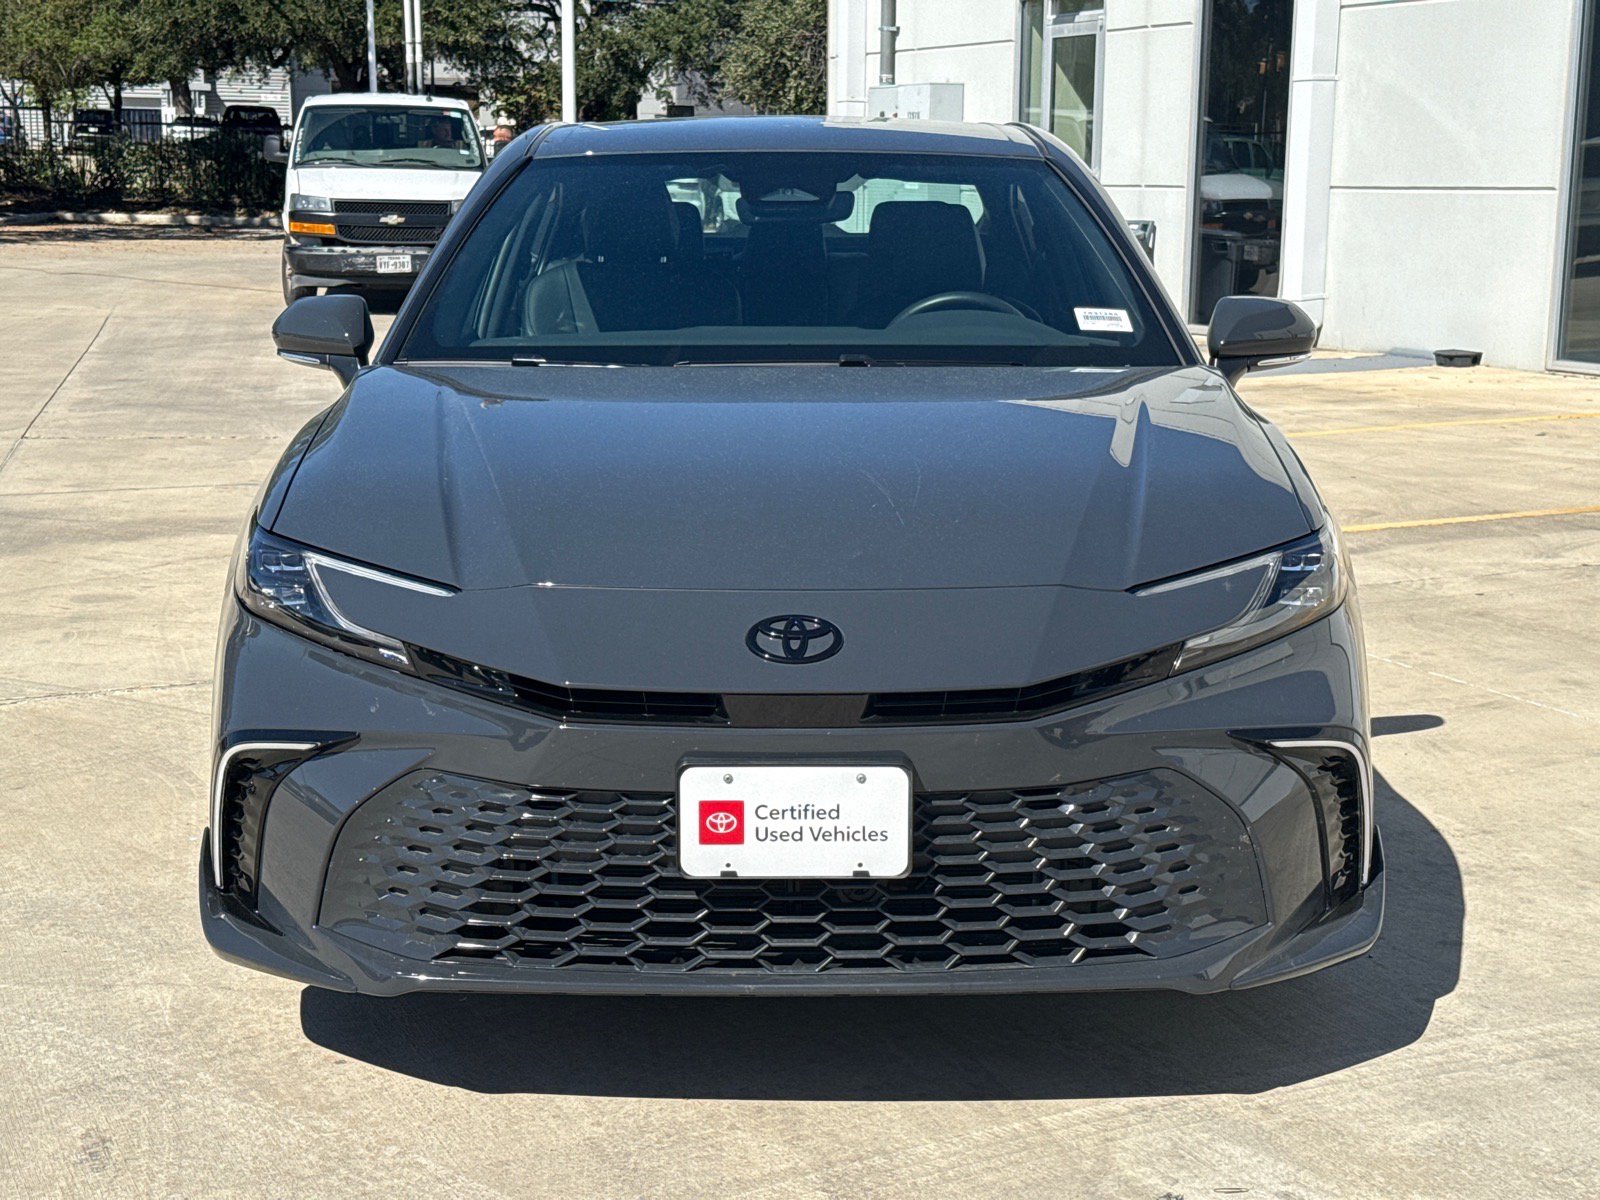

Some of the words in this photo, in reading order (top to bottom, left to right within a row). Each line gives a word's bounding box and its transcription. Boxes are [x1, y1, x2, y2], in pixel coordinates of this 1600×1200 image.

[755, 803, 840, 820] Certified
[755, 826, 803, 842] Used
[809, 826, 888, 842] Vehicles
